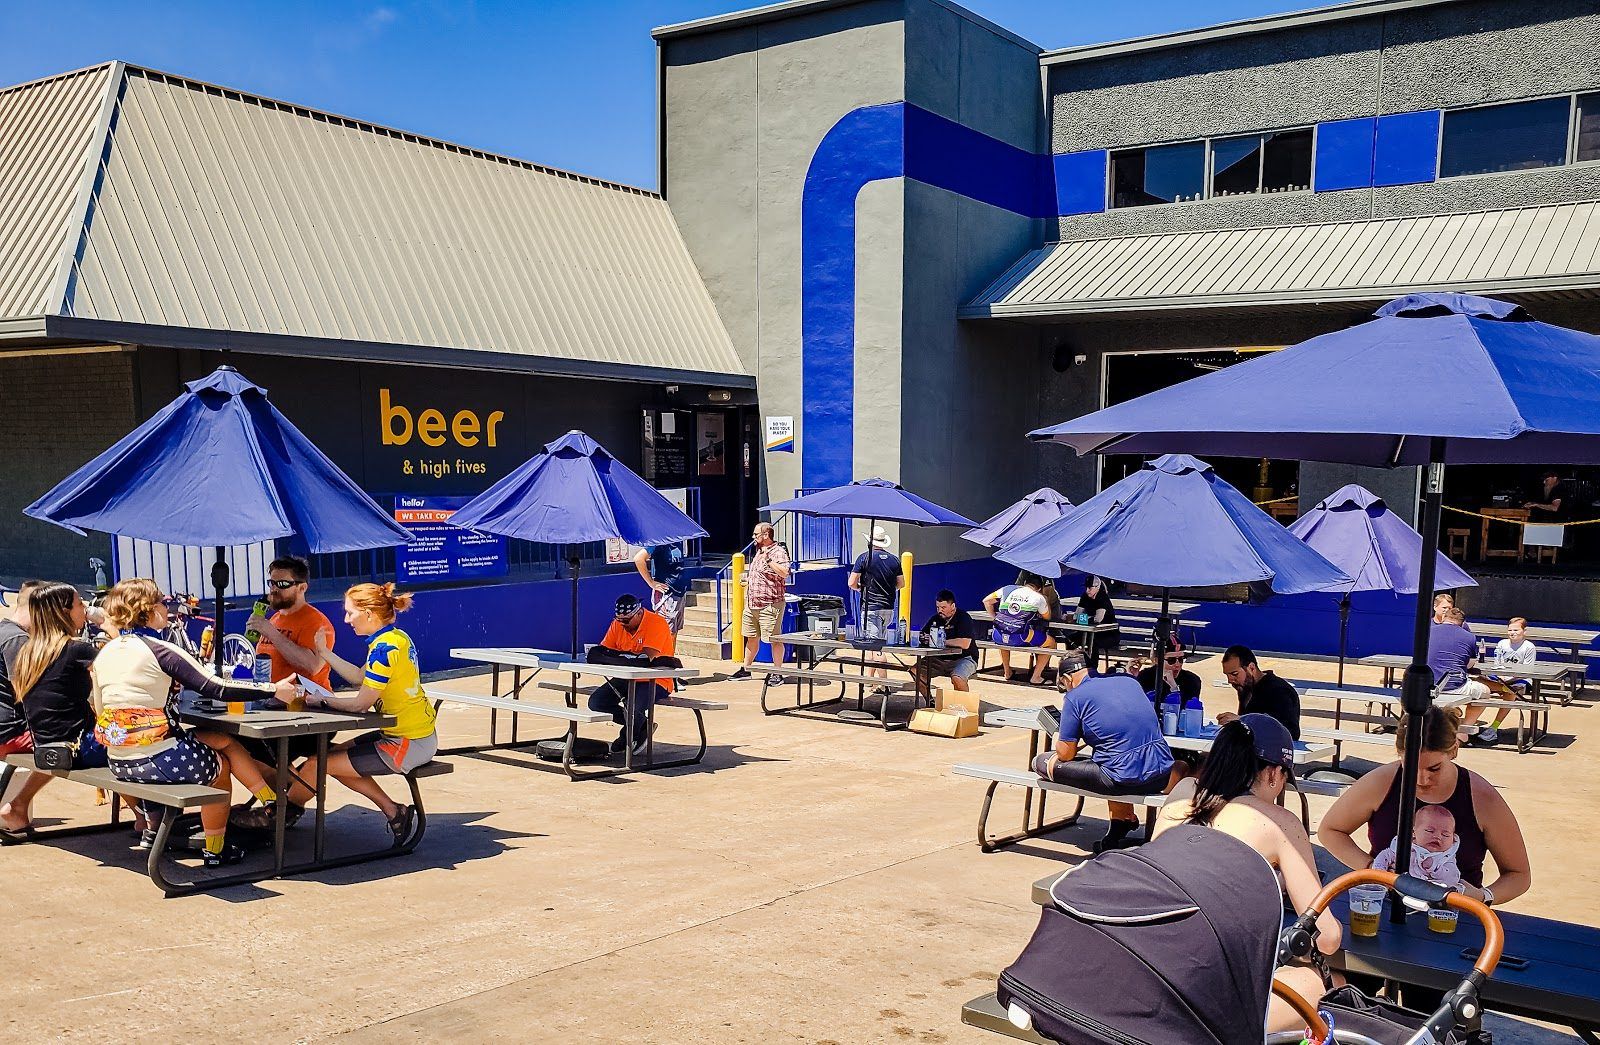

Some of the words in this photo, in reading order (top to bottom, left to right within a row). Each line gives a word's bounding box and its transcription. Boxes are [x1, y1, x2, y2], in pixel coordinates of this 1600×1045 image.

[379, 388, 505, 448] beer
[402, 459, 414, 475] &
[420, 459, 451, 479] high
[455, 458, 487, 474] fives
[401, 498, 424, 506] hello!
[416, 512, 433, 520] TAKE
